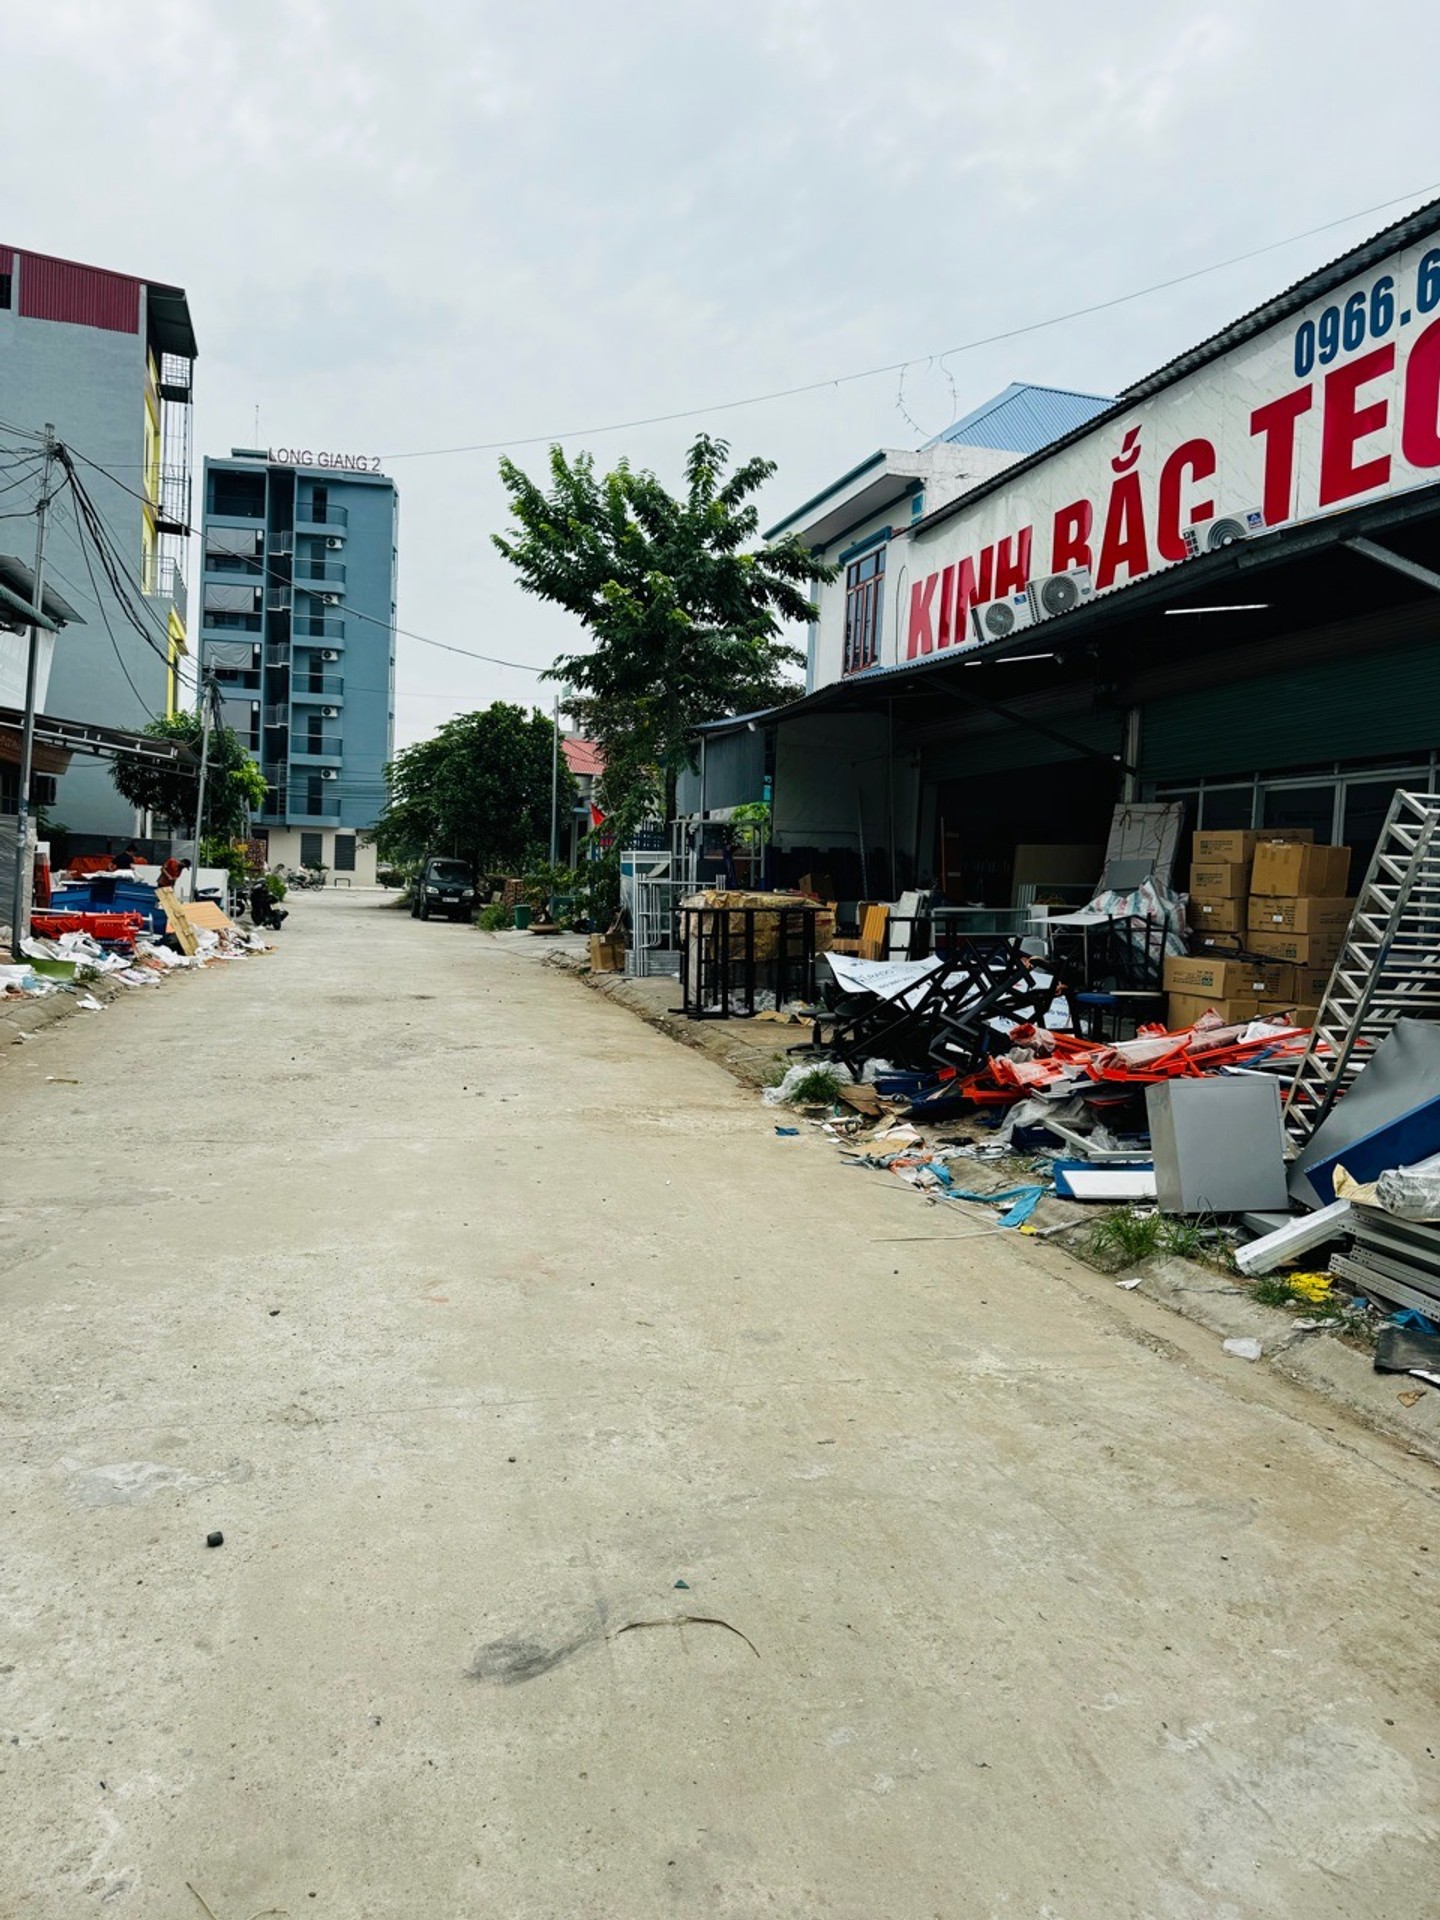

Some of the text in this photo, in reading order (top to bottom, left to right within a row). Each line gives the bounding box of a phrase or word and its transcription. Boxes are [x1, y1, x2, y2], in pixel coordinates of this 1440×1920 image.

[1295, 247, 1440, 378] 0966.6
[268, 447, 381, 471] LONG GIANG 2
[907, 525, 1032, 660] KINH
[1051, 424, 1217, 590] BẮC
